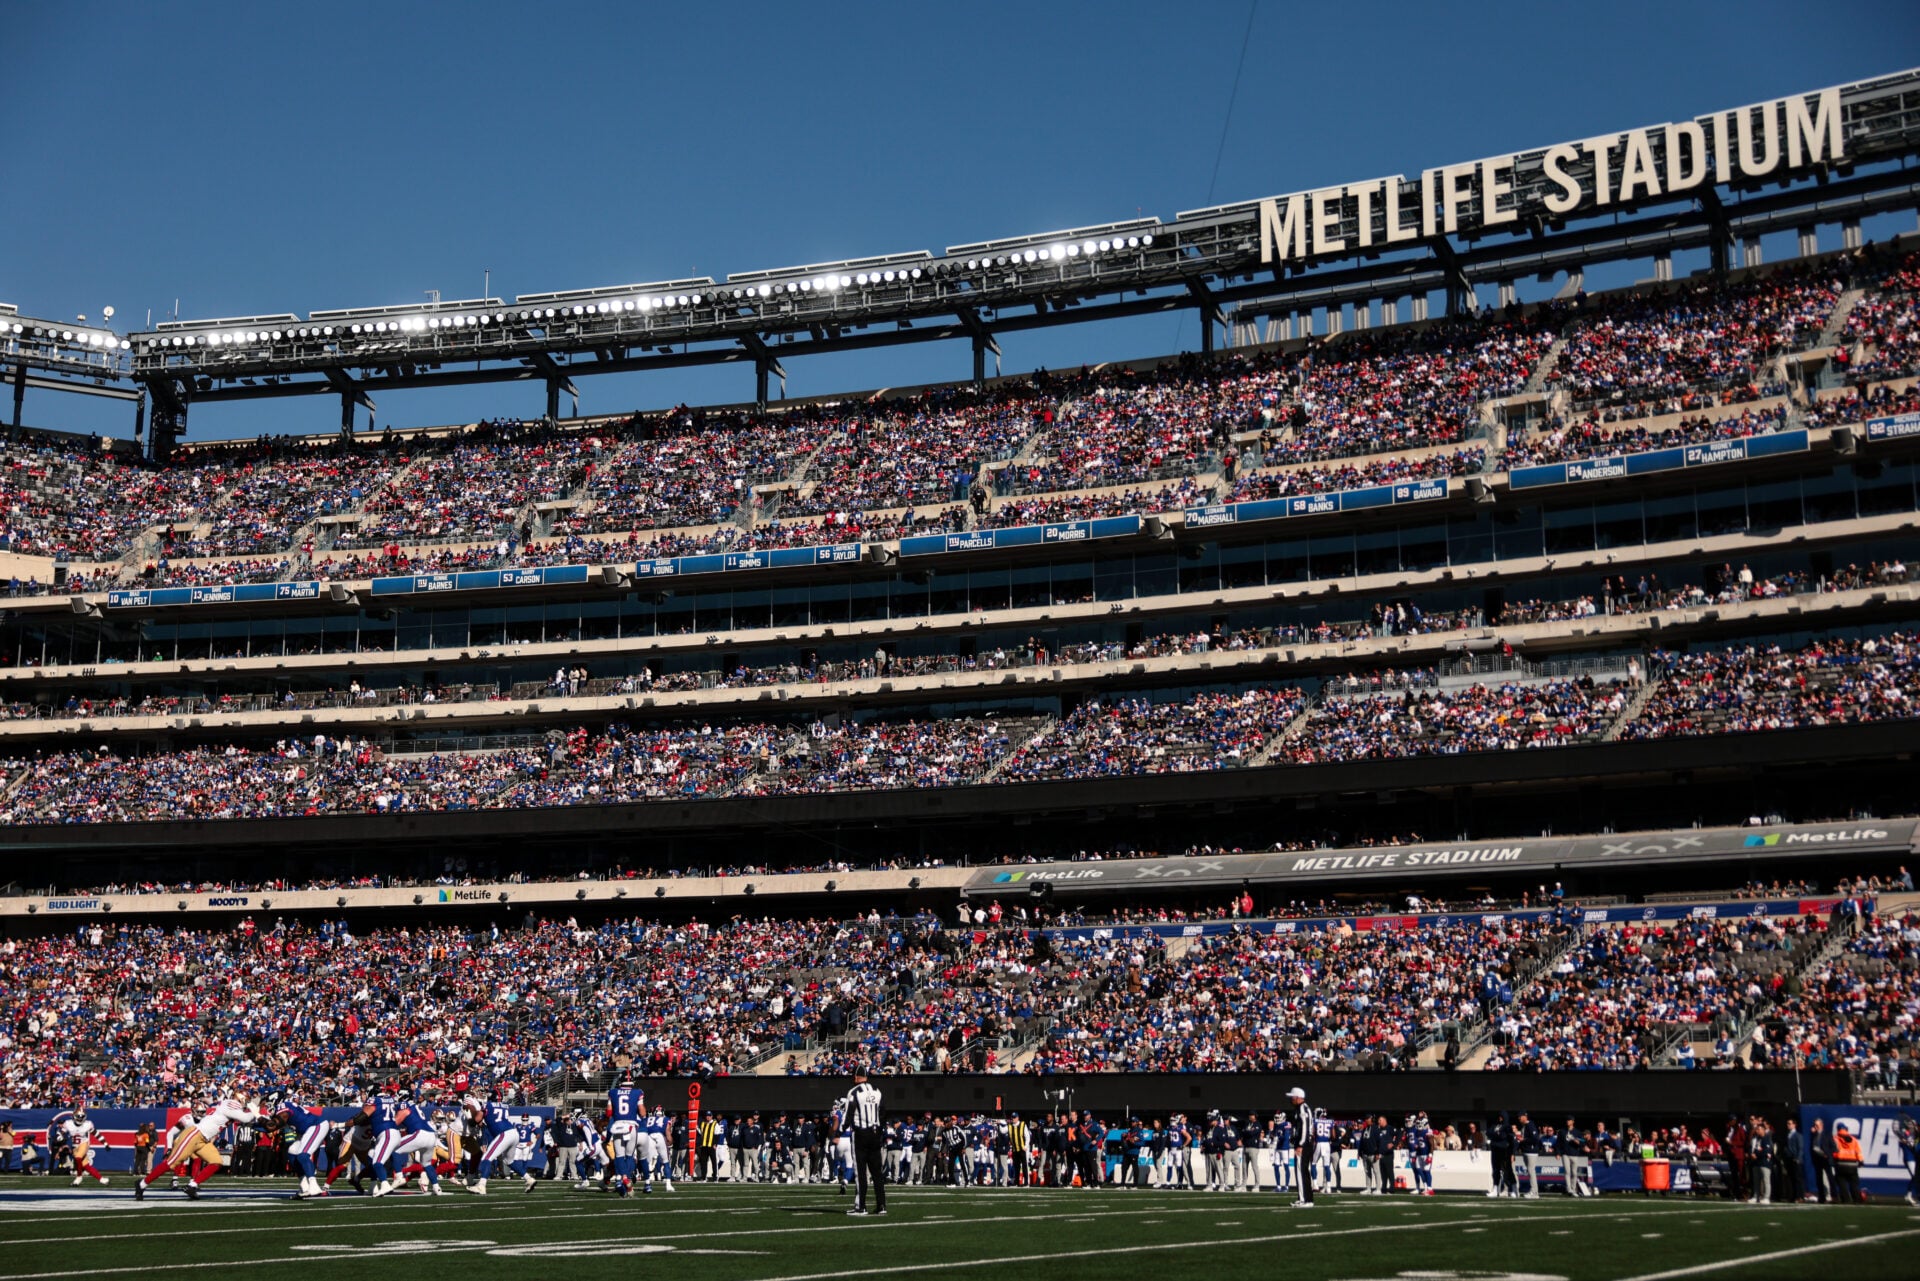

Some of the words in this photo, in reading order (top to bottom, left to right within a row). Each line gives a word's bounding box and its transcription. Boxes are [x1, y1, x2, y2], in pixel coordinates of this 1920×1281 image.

[1260, 155, 1517, 263] METLIFE
[1542, 87, 1845, 214] STADIUM
[1869, 422, 1885, 435] 92
[1688, 449, 1702, 461] 27
[1701, 448, 1743, 464] HAMPTON
[1569, 465, 1582, 477] 24
[1582, 465, 1624, 480] ANDERSON
[1396, 487, 1410, 498] 89
[1413, 487, 1443, 499] BAVARO
[1293, 500, 1306, 511] 58
[1308, 501, 1334, 513] BANKS
[1186, 513, 1198, 523] 70
[1197, 513, 1234, 525] MARSHALL
[1046, 528, 1058, 538] 20
[1058, 529, 1086, 540] MORRIS
[959, 538, 992, 549] PARCELLS
[819, 549, 831, 559] 56
[832, 551, 857, 561] TAYLOR
[727, 556, 737, 566] 11
[739, 558, 762, 568] SIMMS
[652, 565, 674, 575] YOUNG
[503, 573, 514, 582] 53
[515, 575, 541, 584] CARSON
[279, 586, 290, 595] 75
[291, 588, 315, 597] MARTIN
[428, 581, 453, 590] BARNES
[110, 594, 119, 604] 10
[121, 597, 133, 606] VAN
[133, 596, 148, 605] PELT
[193, 590, 203, 600] 13
[202, 592, 231, 602] JENNINGS
[1785, 829, 1889, 844] MetLife
[1291, 853, 1400, 871] METLIFE
[1404, 847, 1523, 865] STADIUM
[1026, 868, 1104, 881] MetLife
[454, 889, 492, 900] MetLife
[49, 901, 69, 910] BUD
[70, 900, 99, 909] LIGHT
[208, 897, 249, 907] MOODY'S
[618, 1095, 630, 1115] 6
[646, 1116, 664, 1128] 84
[520, 1130, 527, 1139] 3
[1316, 1122, 1331, 1137] 85
